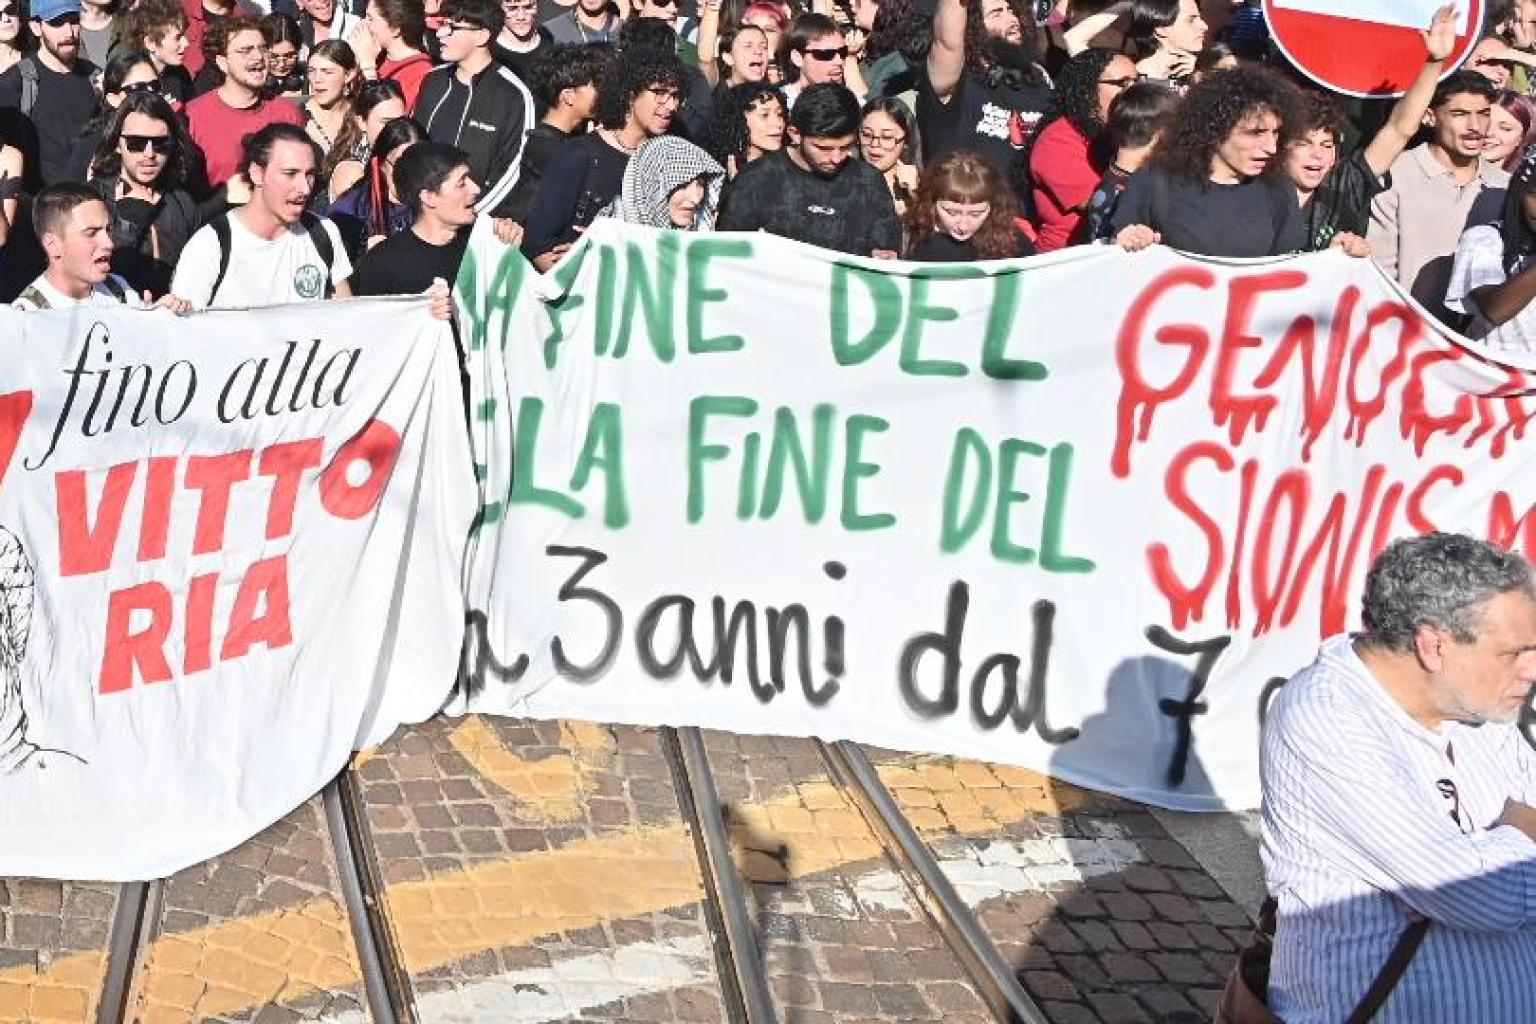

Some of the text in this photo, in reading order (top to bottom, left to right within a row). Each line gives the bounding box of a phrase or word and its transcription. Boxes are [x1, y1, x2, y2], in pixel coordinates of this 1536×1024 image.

[543, 232, 755, 370] FINE
[830, 260, 1049, 382] DEL
[23, 320, 363, 471] fino alla
[54, 417, 404, 577] VITTO
[938, 426, 1099, 575] DEL
[98, 554, 293, 696] RIA
[544, 544, 625, 685] 3
[633, 560, 849, 709] anni
[896, 579, 1081, 745] dal
[1144, 623, 1233, 788] 7
